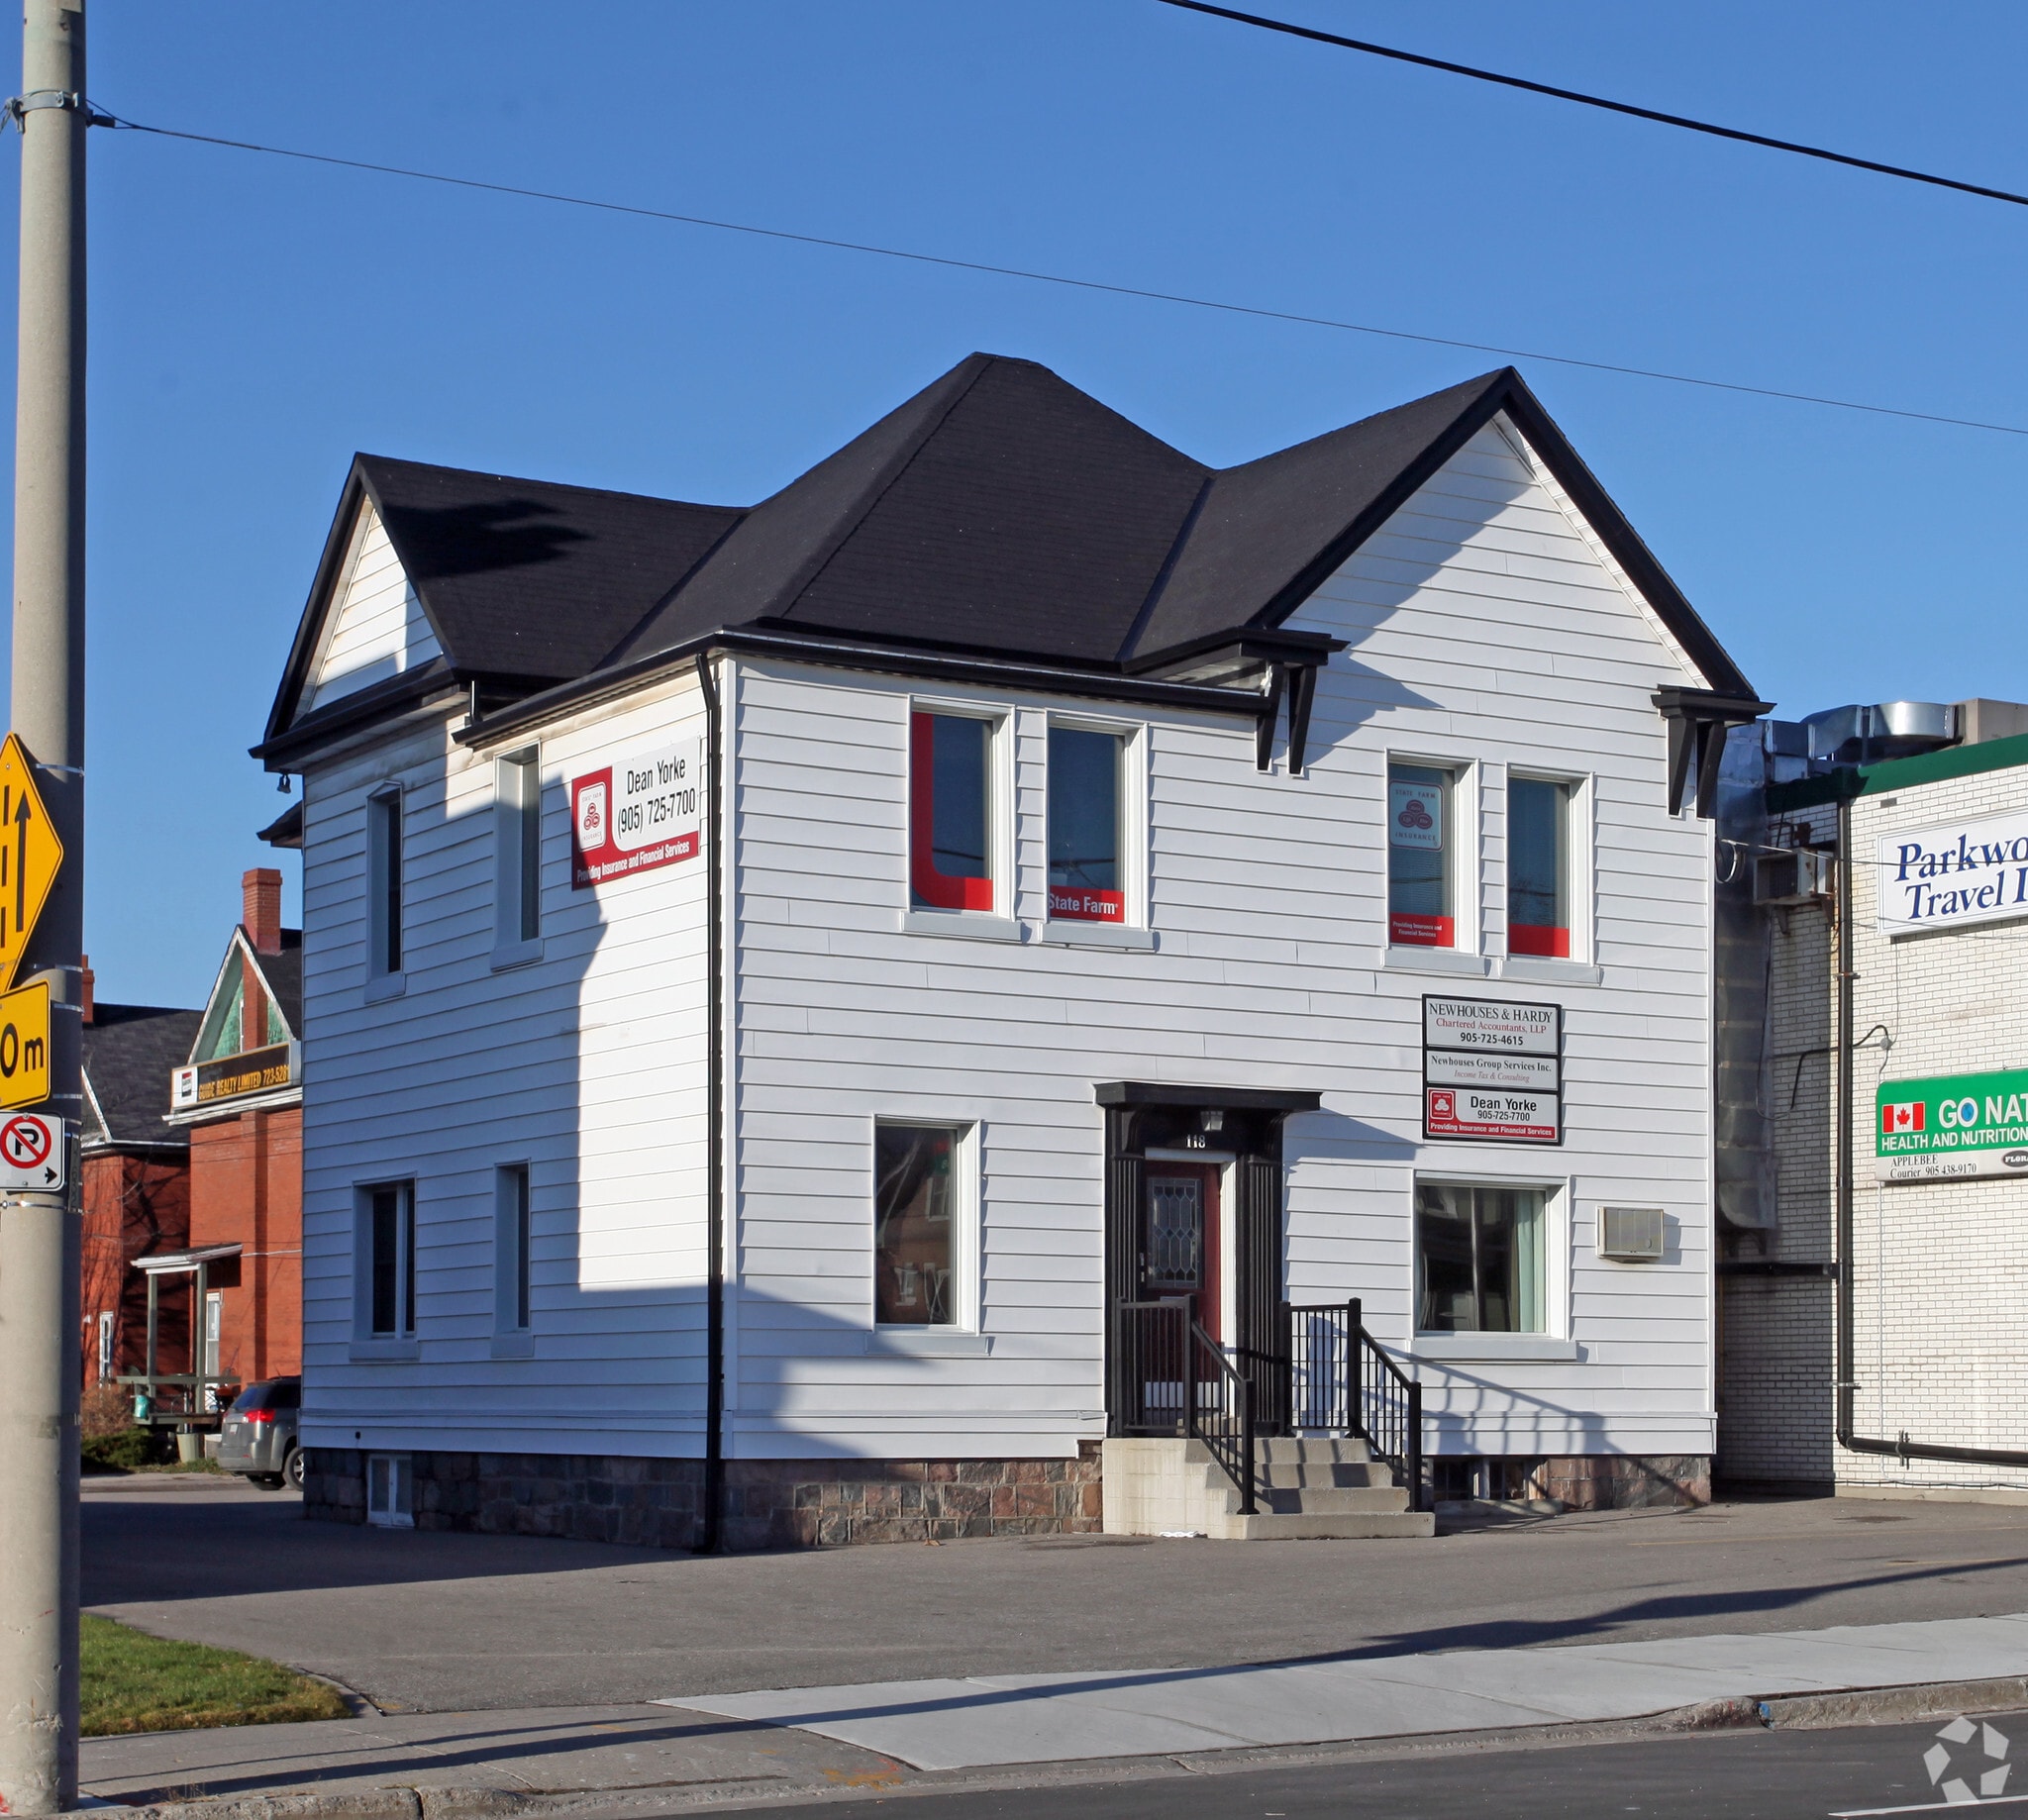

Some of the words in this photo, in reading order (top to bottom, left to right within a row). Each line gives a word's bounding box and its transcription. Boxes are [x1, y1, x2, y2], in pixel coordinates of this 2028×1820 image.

[628, 769, 653, 794] Dean
[658, 756, 685, 785] Yorke
[618, 803, 644, 839] (905)
[648, 788, 695, 825] 725-7700
[577, 865, 601, 882] Providing
[602, 859, 628, 876] Insurance
[629, 856, 639, 868] and
[640, 846, 663, 865] Financial
[665, 841, 689, 859] Services
[1904, 869, 2005, 920] Travel
[1050, 893, 1079, 911] State
[1083, 896, 1116, 915] Farm
[1429, 1003, 1498, 1019] NEWHOUSES
[1501, 1009, 1510, 1020] &
[1513, 1009, 1553, 1023] HARDY
[1436, 1018, 1475, 1029] Chartered
[1477, 1023, 1527, 1033] Accountants,
[1530, 1025, 1546, 1034] LLP
[1460, 1032, 1523, 1046] 905-725-4615
[1431, 1056, 1474, 1067] Newhouses
[1476, 1058, 1502, 1070] Group
[1503, 1060, 1535, 1070] Services
[1537, 1062, 1552, 1072] Inc.
[216, 1076, 238, 1096] REALTY
[238, 1071, 261, 1091] LIMITED
[1454, 1069, 1476, 1078] Income
[1477, 1070, 1489, 1079] Tax
[1497, 1072, 1530, 1083] Consulting
[1470, 1096, 1500, 1109] Dean
[1504, 1098, 1537, 1111] Yorke
[1477, 1111, 1530, 1121] 905-725-7700
[1938, 1097, 1978, 1129] GO
[1430, 1123, 1458, 1132] Providing
[1459, 1124, 1486, 1133] Insurance
[15, 1129, 39, 1156] P
[1186, 1134, 1205, 1148] 118
[1881, 1134, 1928, 1151] HEALTH
[1932, 1132, 1958, 1148] AND
[1961, 1127, 2028, 1146] NUTRITION
[1891, 1155, 1938, 1167] APPLEBEE
[1890, 1166, 1921, 1179] Courier
[1925, 1165, 1940, 1176] 905
[1941, 1163, 1977, 1176] 438-9170
